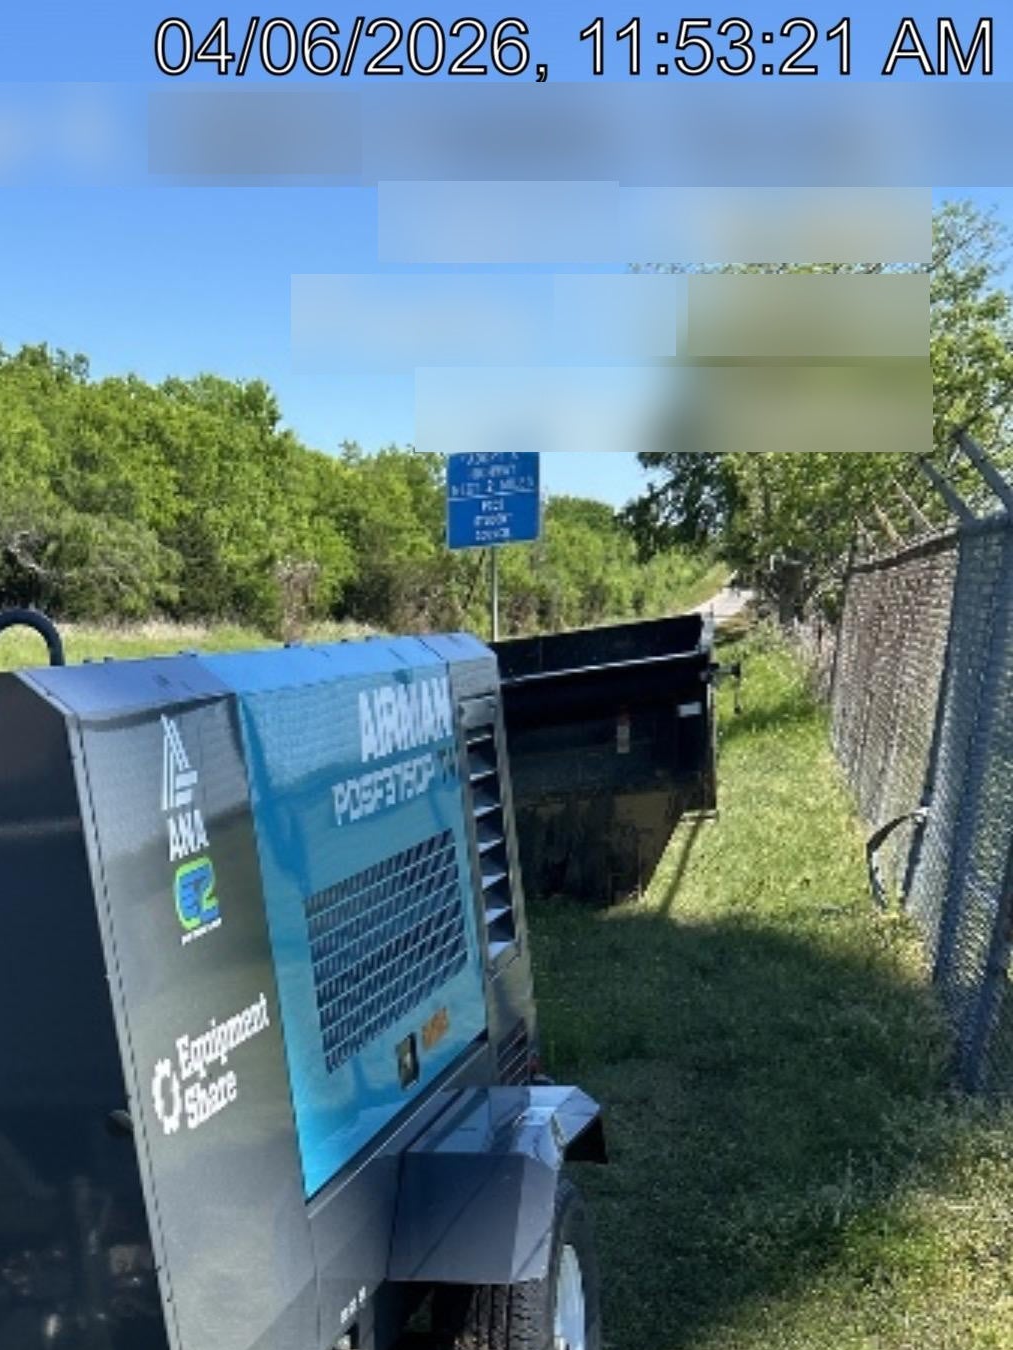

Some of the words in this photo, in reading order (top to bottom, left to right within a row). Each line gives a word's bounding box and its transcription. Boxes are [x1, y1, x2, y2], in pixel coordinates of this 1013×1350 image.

[359, 677, 453, 763] AIRMAN
[168, 809, 210, 862] ANA
[175, 991, 270, 1080] Equipment
[184, 1070, 237, 1129] Share
